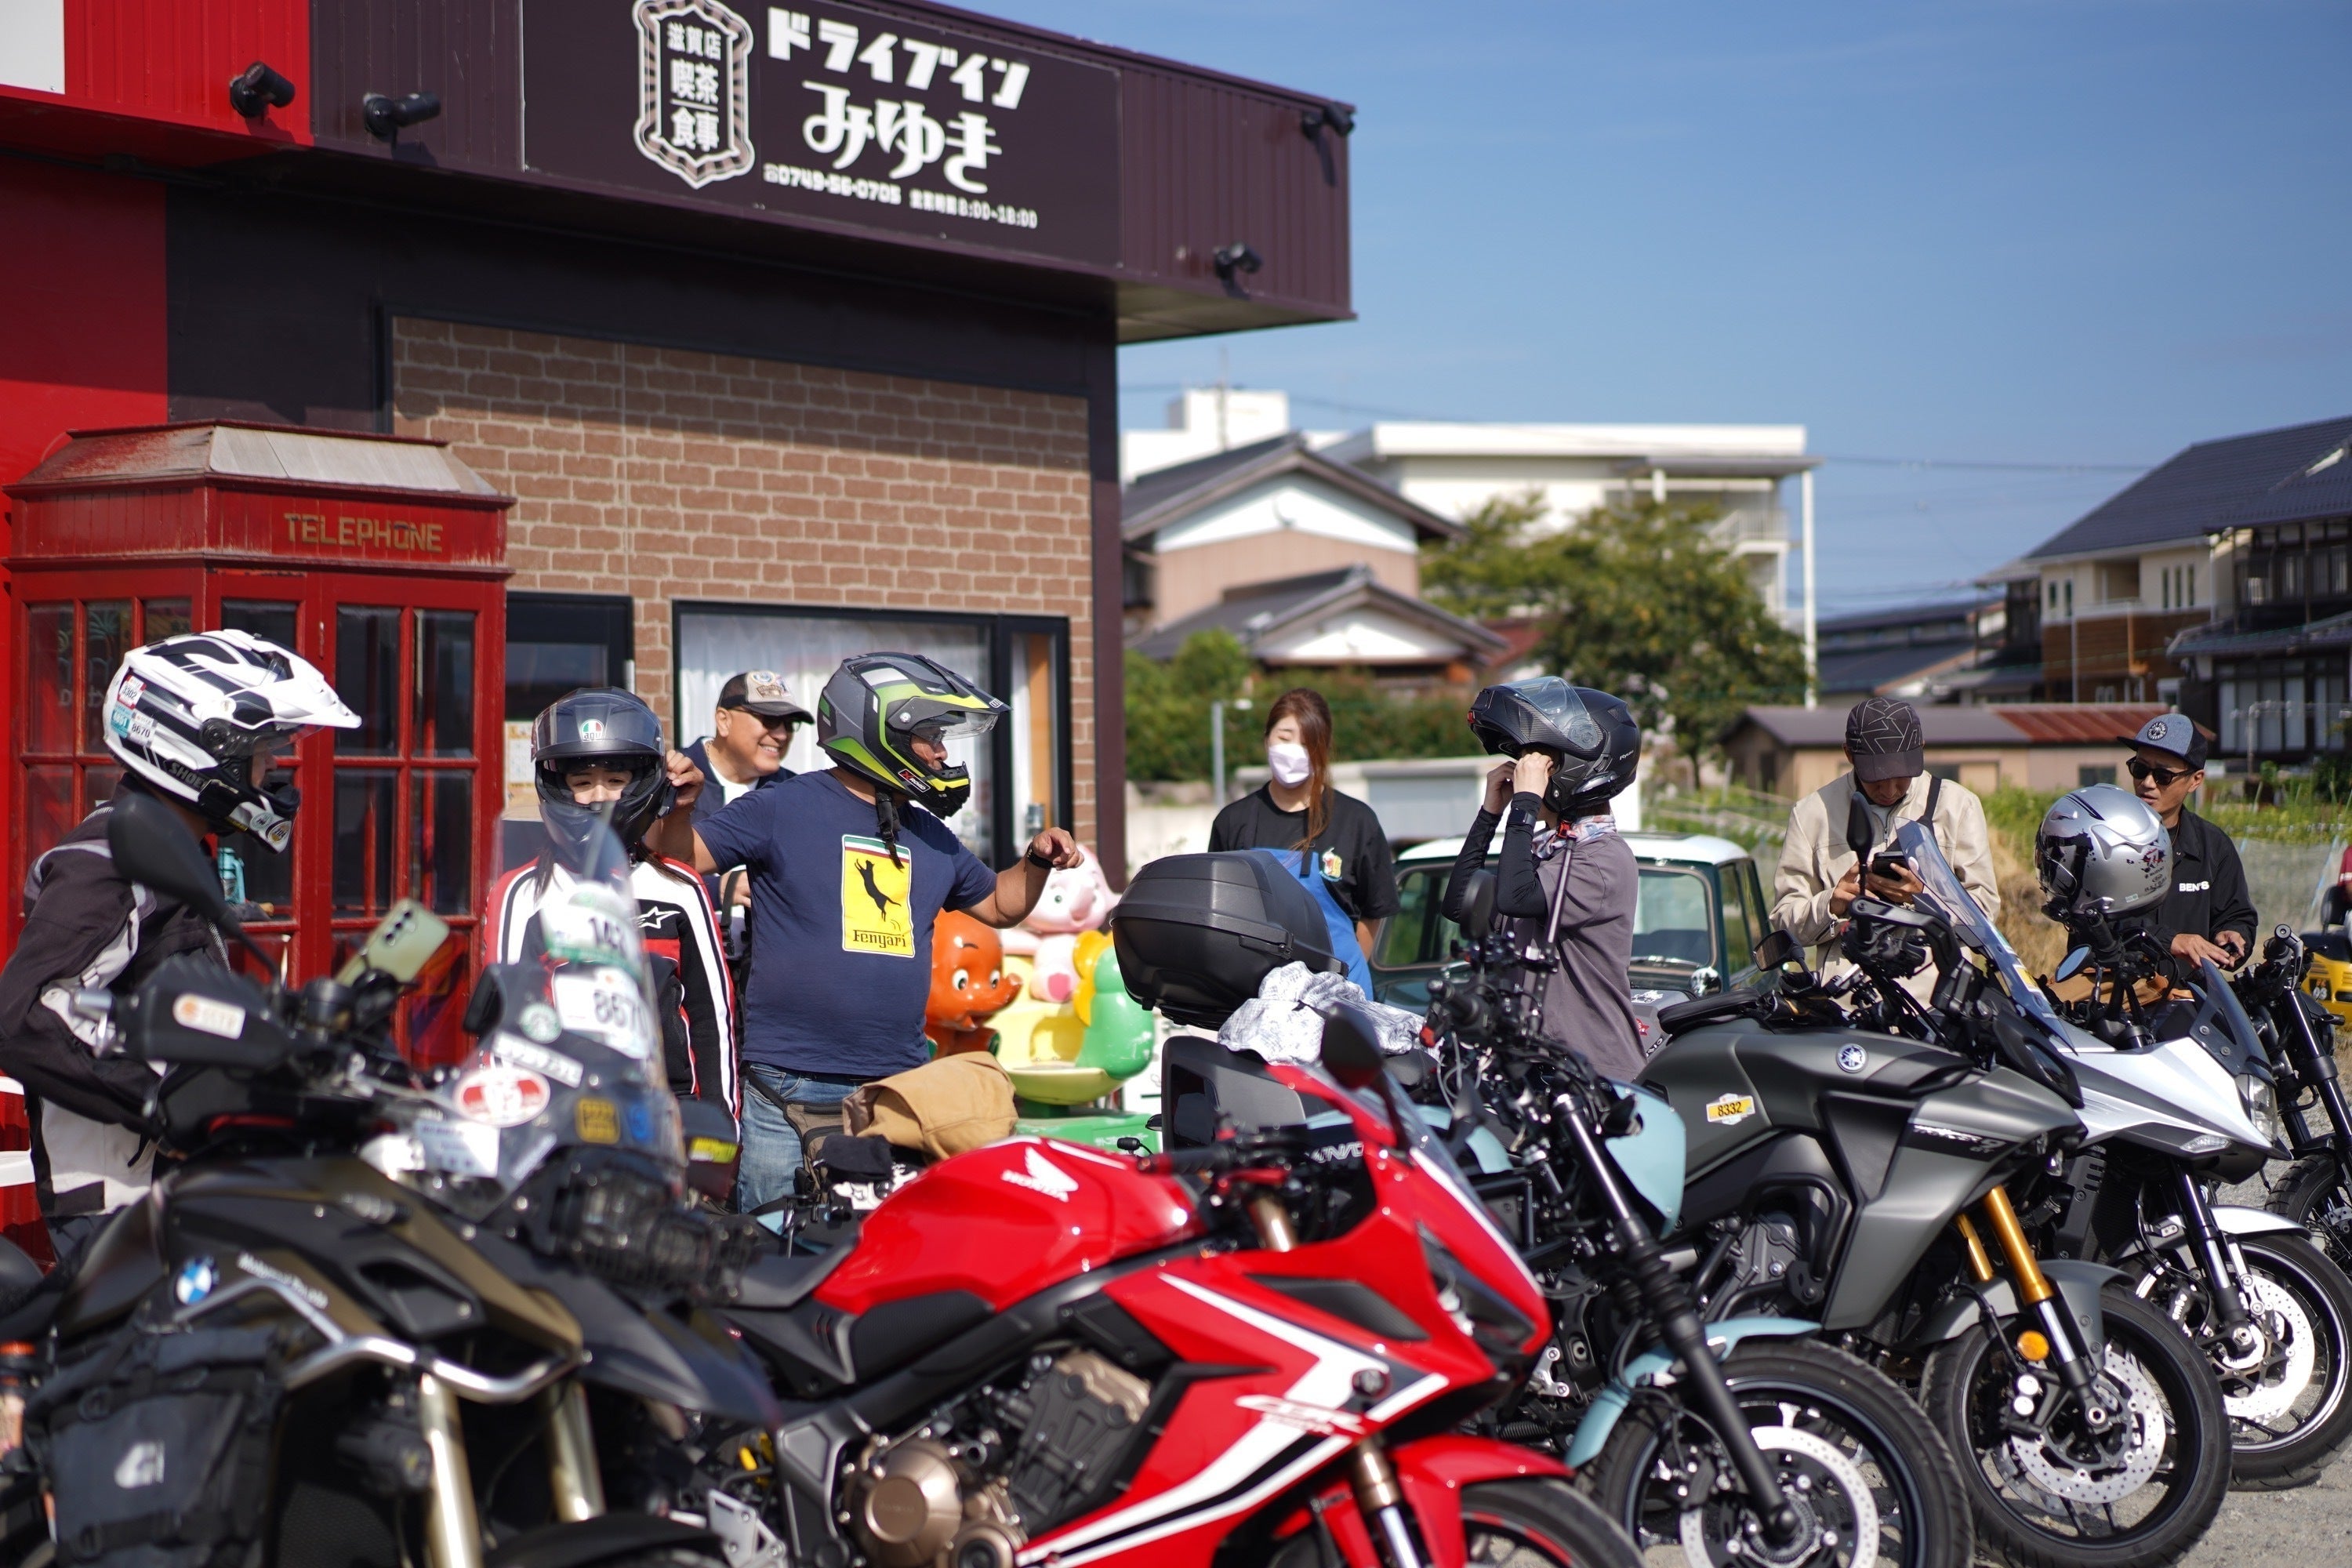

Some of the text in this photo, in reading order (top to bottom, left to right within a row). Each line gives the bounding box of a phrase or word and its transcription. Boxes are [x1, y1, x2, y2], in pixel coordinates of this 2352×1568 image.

[666, 21, 722, 61] 滋賀店
[767, 6, 1031, 110] ドライブイン
[670, 58, 720, 105] 喫茶
[670, 107, 720, 153] 食事
[801, 80, 1003, 194] みゆき
[284, 513, 444, 554] TELEPHONE
[131, 723, 151, 738] 8670
[853, 929, 906, 949] Fenyari
[1718, 1102, 1742, 1117] 8332
[1000, 1169, 1069, 1203] HONDA
